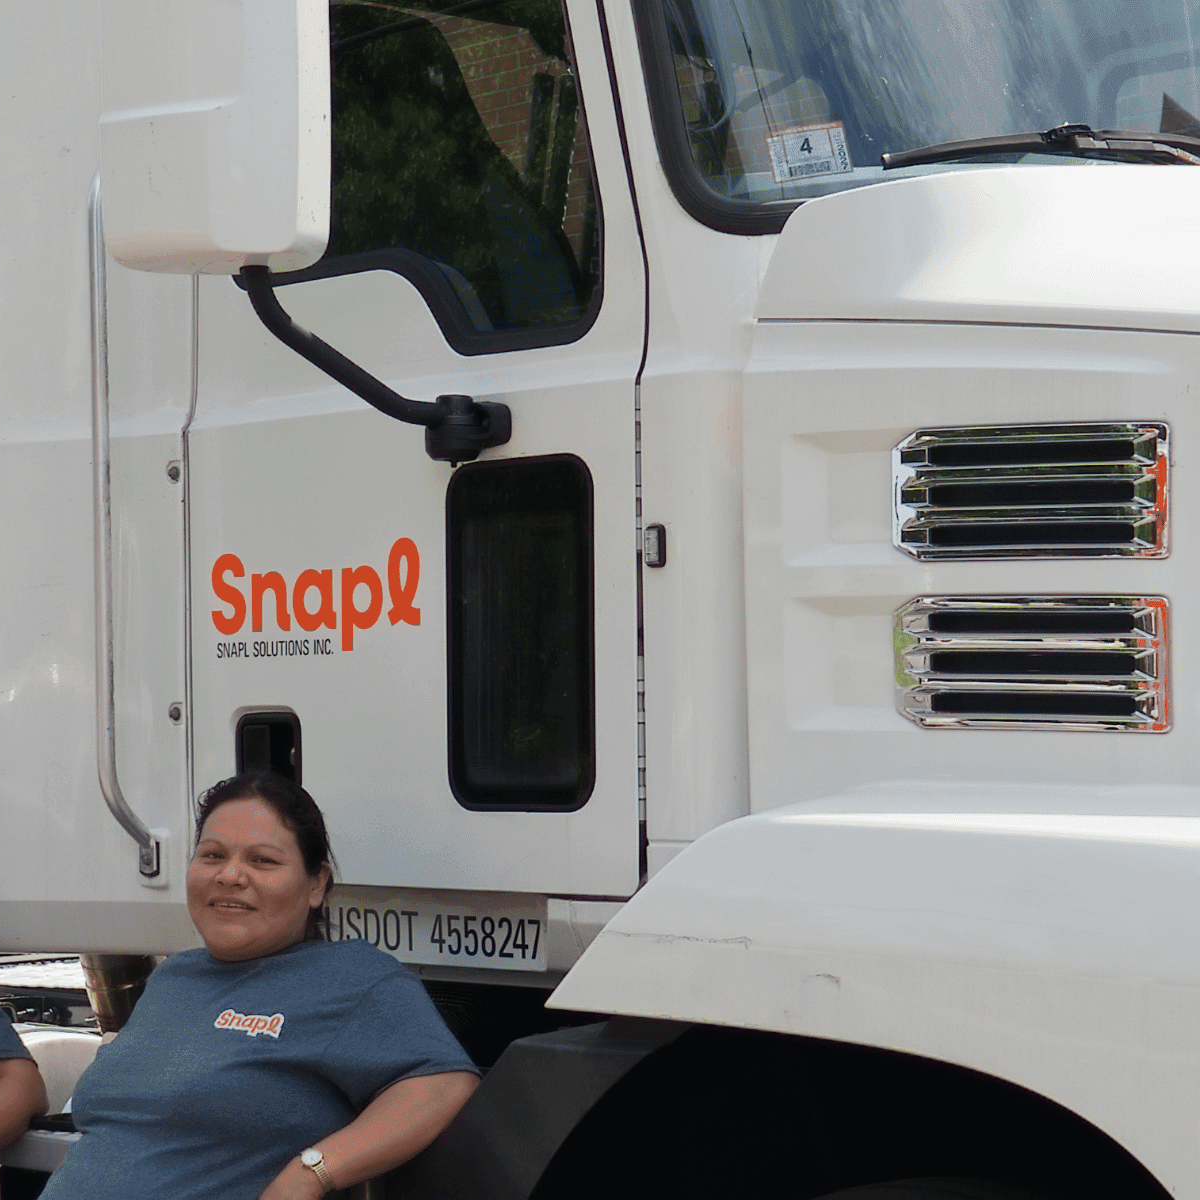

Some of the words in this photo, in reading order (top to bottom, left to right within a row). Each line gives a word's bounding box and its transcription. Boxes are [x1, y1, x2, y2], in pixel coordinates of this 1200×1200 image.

[801, 138, 812, 153] 4
[211, 537, 421, 651] Snapl
[217, 642, 250, 658] SNAPL
[253, 639, 309, 657] SOLUTIONS
[313, 638, 334, 656] INC.
[326, 906, 418, 952] USDOT
[430, 913, 541, 960] 4558247
[215, 1010, 283, 1036] Snapl
